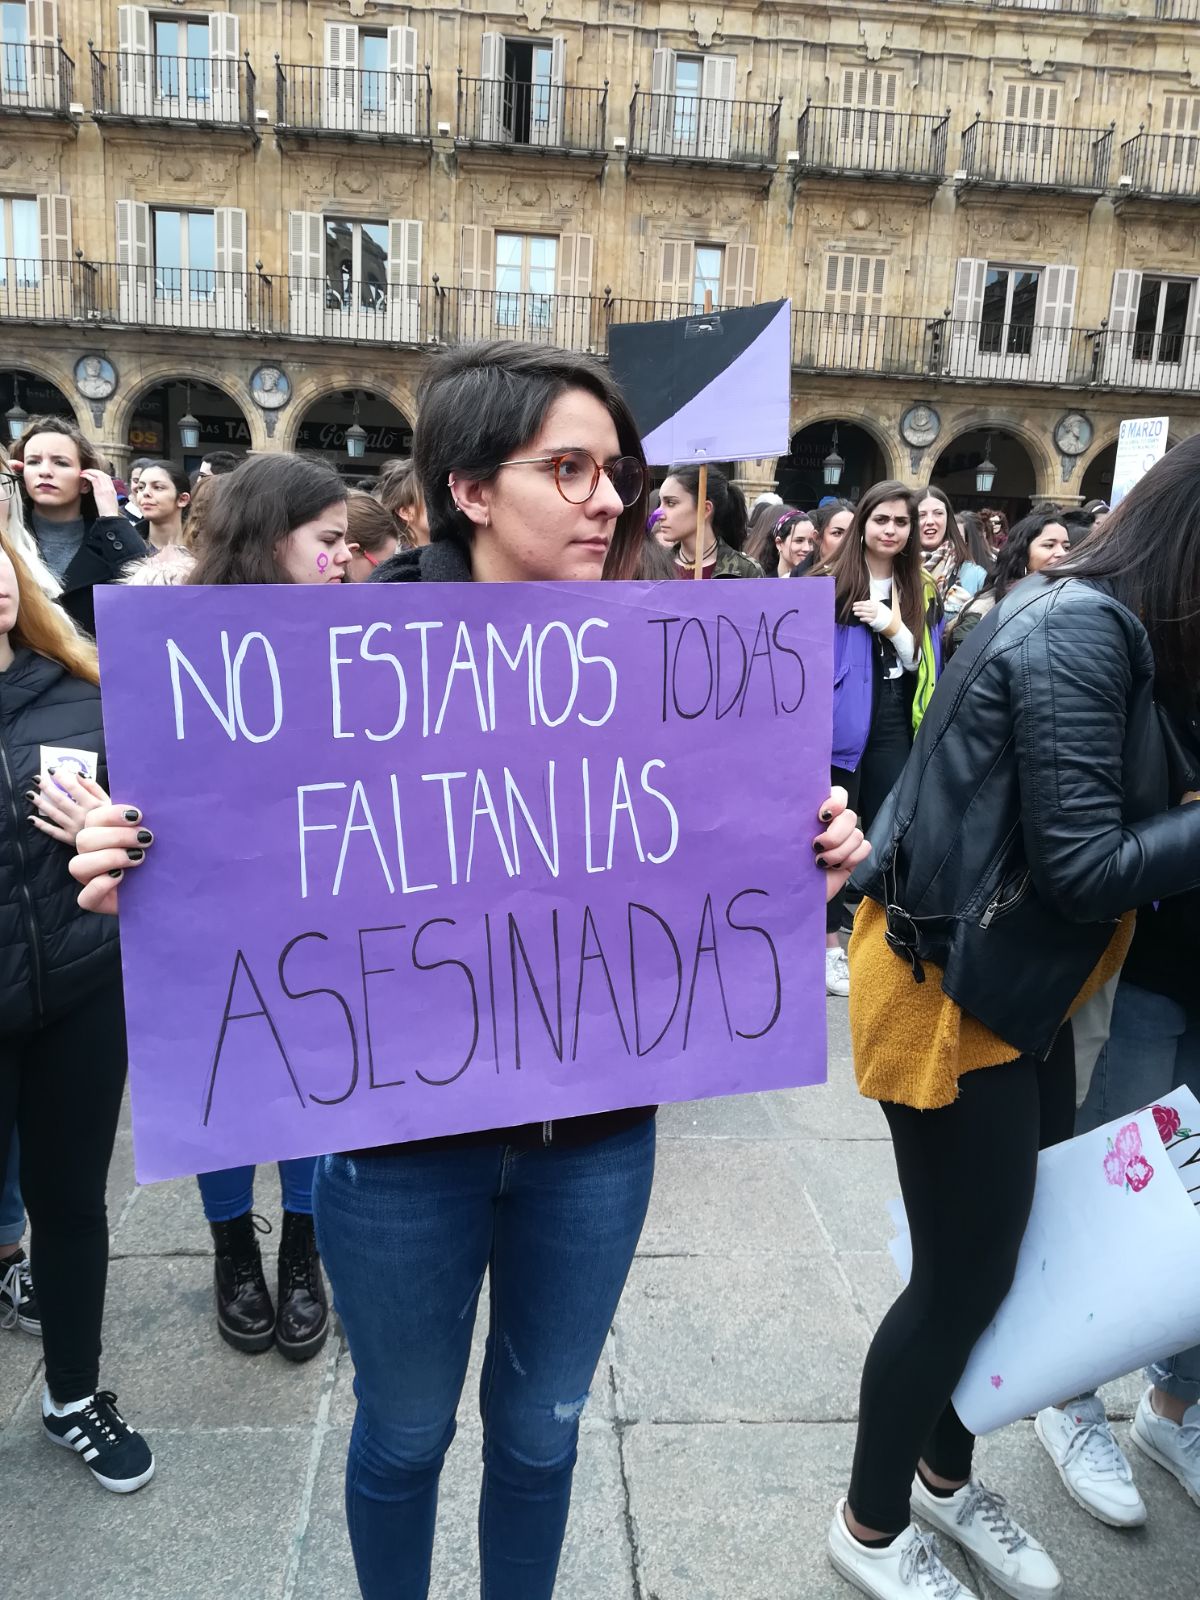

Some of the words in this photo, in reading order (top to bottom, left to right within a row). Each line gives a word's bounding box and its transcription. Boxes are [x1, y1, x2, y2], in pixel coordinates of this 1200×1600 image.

[200, 423, 219, 434] LAS
[224, 421, 250, 440] TA
[319, 423, 397, 449] Goalo
[1120, 423, 1127, 439] 8
[1127, 420, 1163, 439] MARZO
[166, 629, 283, 743] NO
[329, 617, 617, 742] ESTAMOS
[648, 609, 807, 722] TODAS
[296, 760, 560, 898] FALTAN
[584, 758, 680, 873] LAS
[202, 888, 783, 1127] ASESINADAS
